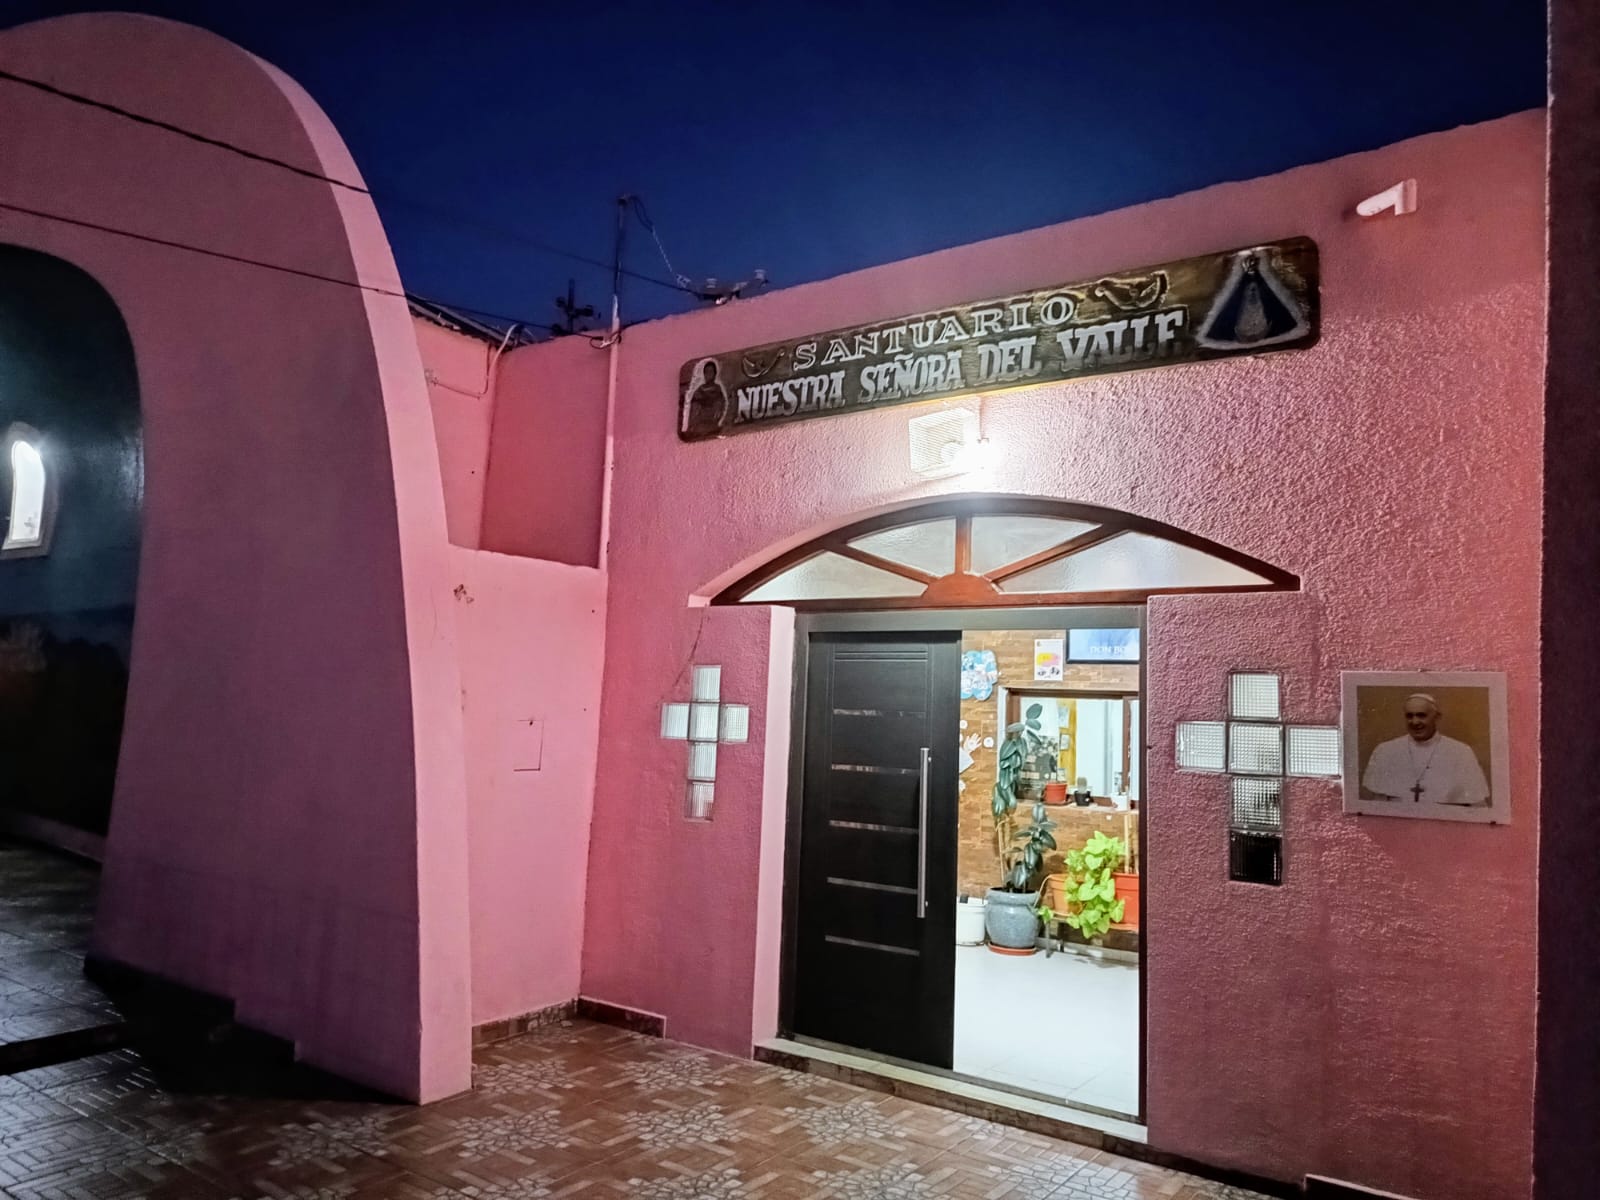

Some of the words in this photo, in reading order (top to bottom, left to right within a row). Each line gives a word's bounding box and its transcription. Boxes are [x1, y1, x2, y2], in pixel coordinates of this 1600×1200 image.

[735, 369, 846, 423] NUESTRA
[858, 352, 965, 404] SEÑORA
[973, 335, 1043, 386] DEL
[1056, 310, 1184, 372] VALLE
[792, 295, 1074, 372] SANTUARIO
